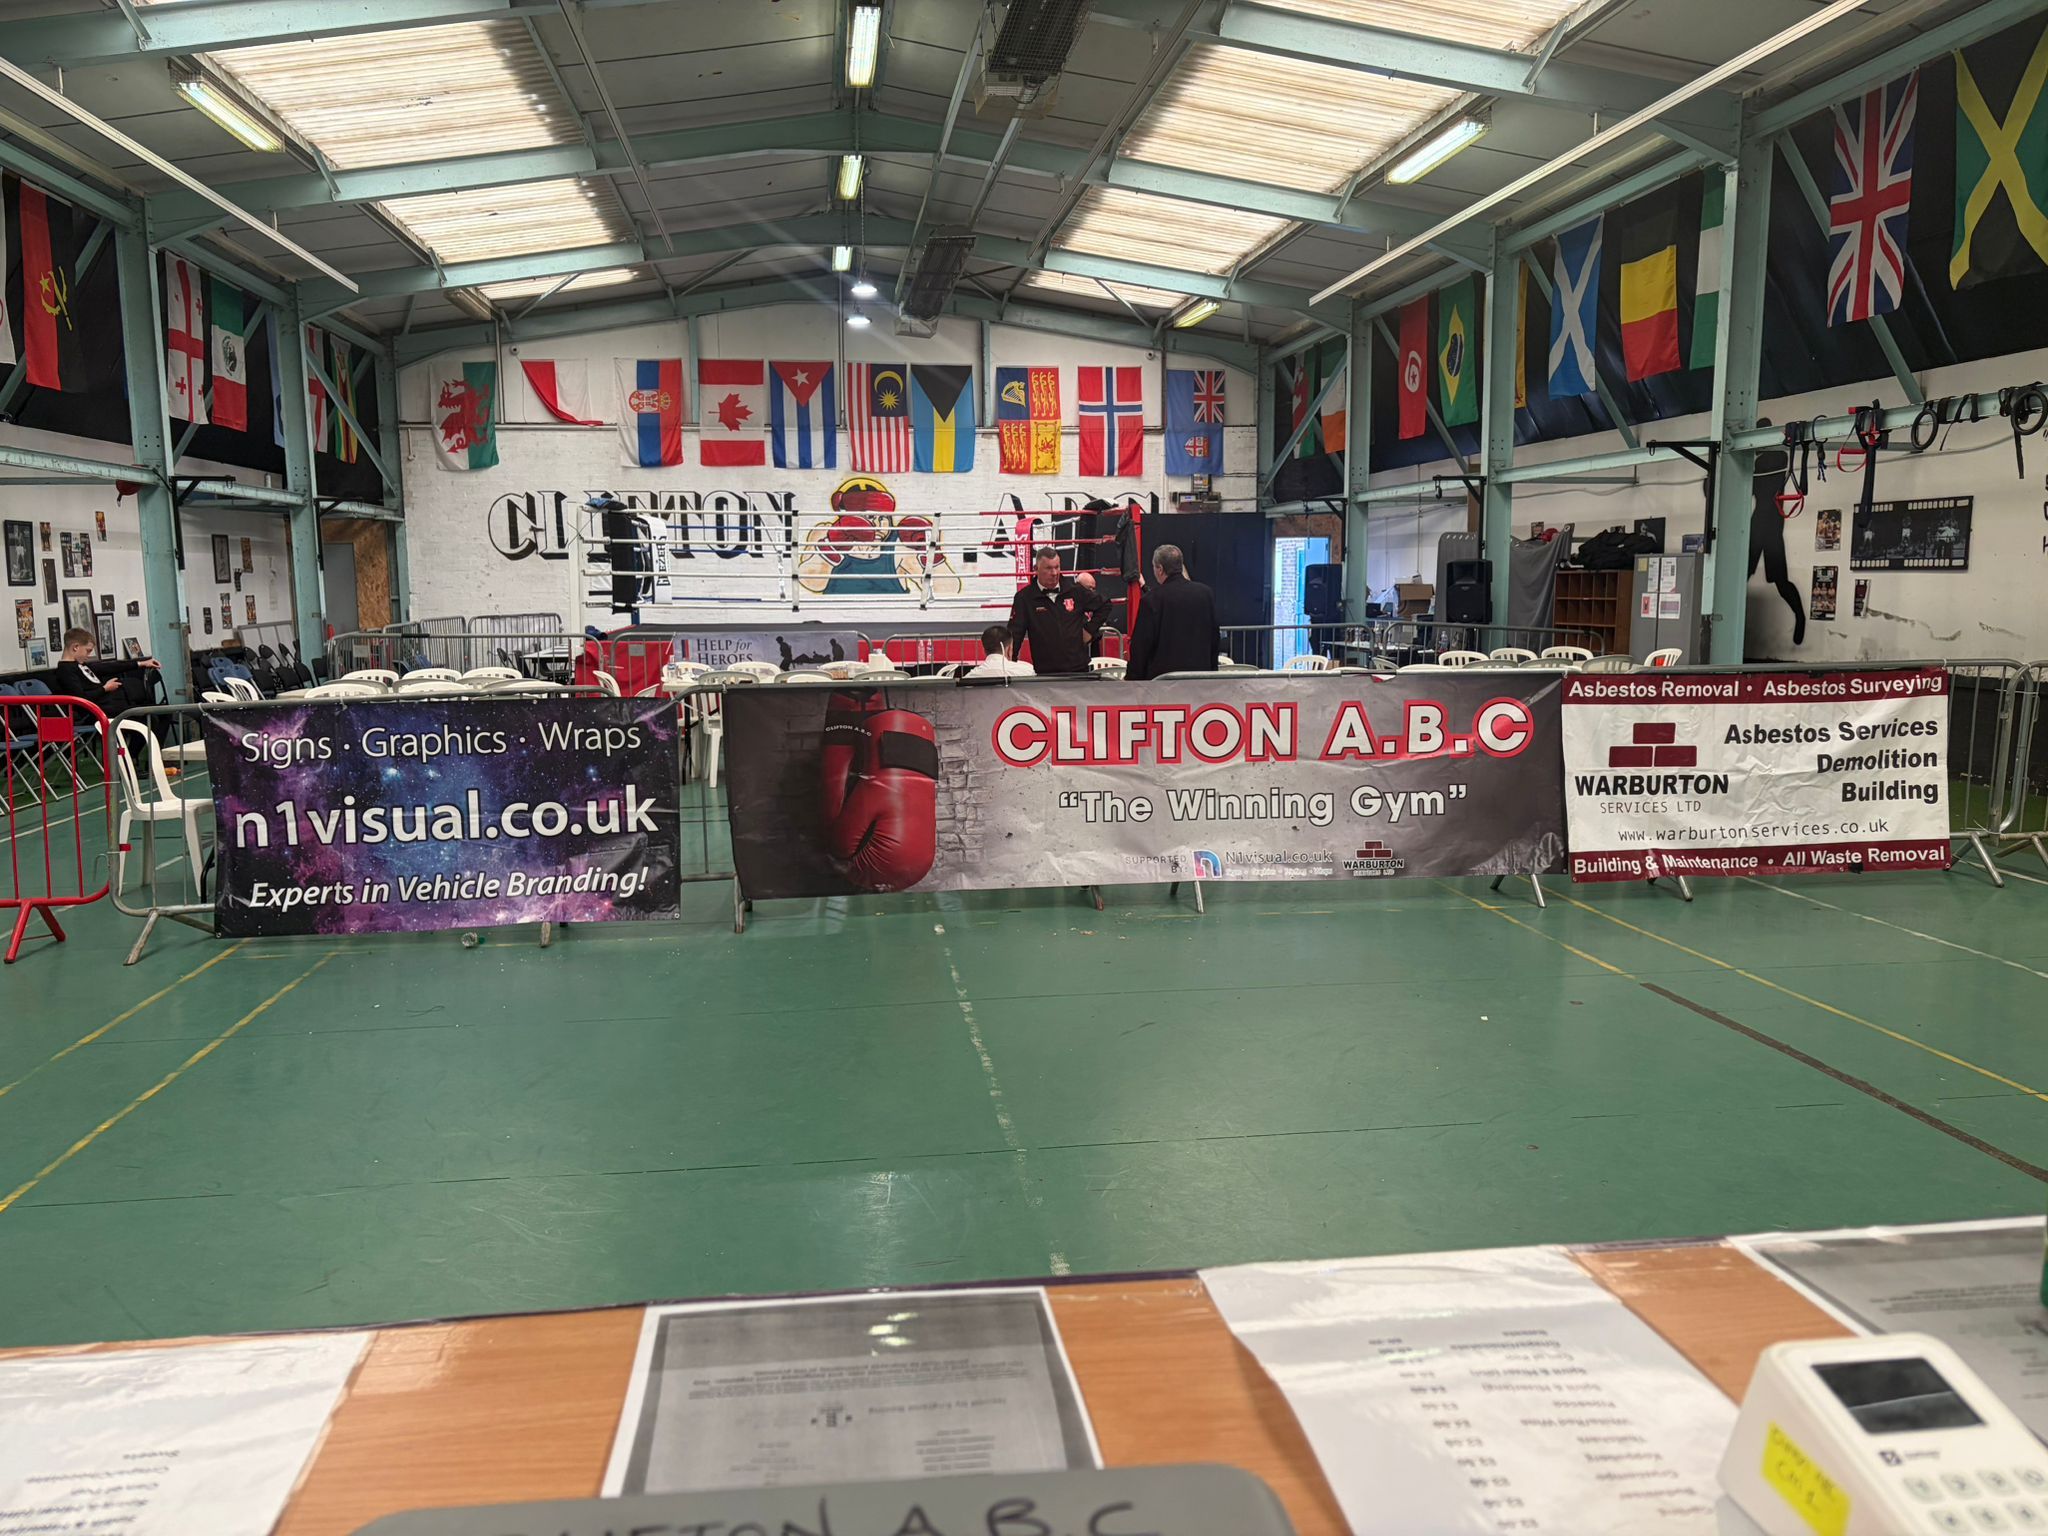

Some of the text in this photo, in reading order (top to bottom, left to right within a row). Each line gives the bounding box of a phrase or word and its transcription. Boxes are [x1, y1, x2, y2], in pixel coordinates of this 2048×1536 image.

[697, 638, 753, 654] HELP for
[697, 653, 753, 664] HEROES
[1568, 676, 1943, 698] Asbestos Removal Asbestos Surveying
[992, 697, 1534, 767] CLIFTON A.B.C
[1724, 720, 1938, 745] Asbestos Services
[240, 721, 642, 770] Signs Graphics Wraps
[1816, 752, 1938, 774] Demolition
[1575, 774, 1729, 797] WARBURTON
[1841, 781, 1939, 805] Building
[234, 784, 659, 848] n1visual.co.uk
[1166, 788, 1333, 827] Winning
[1600, 800, 1702, 814] SERVICES LTD
[1618, 818, 1889, 843] www.warburtonservices.co.uk
[1125, 854, 1187, 865] SUPPORTED
[1225, 849, 1333, 863] N1visual.co.uk
[1343, 859, 1404, 870] WARBURTON
[1574, 846, 1945, 876] Building & Maintenance All Waste Removal
[249, 867, 647, 913] Experts in Vehicle Branding!
